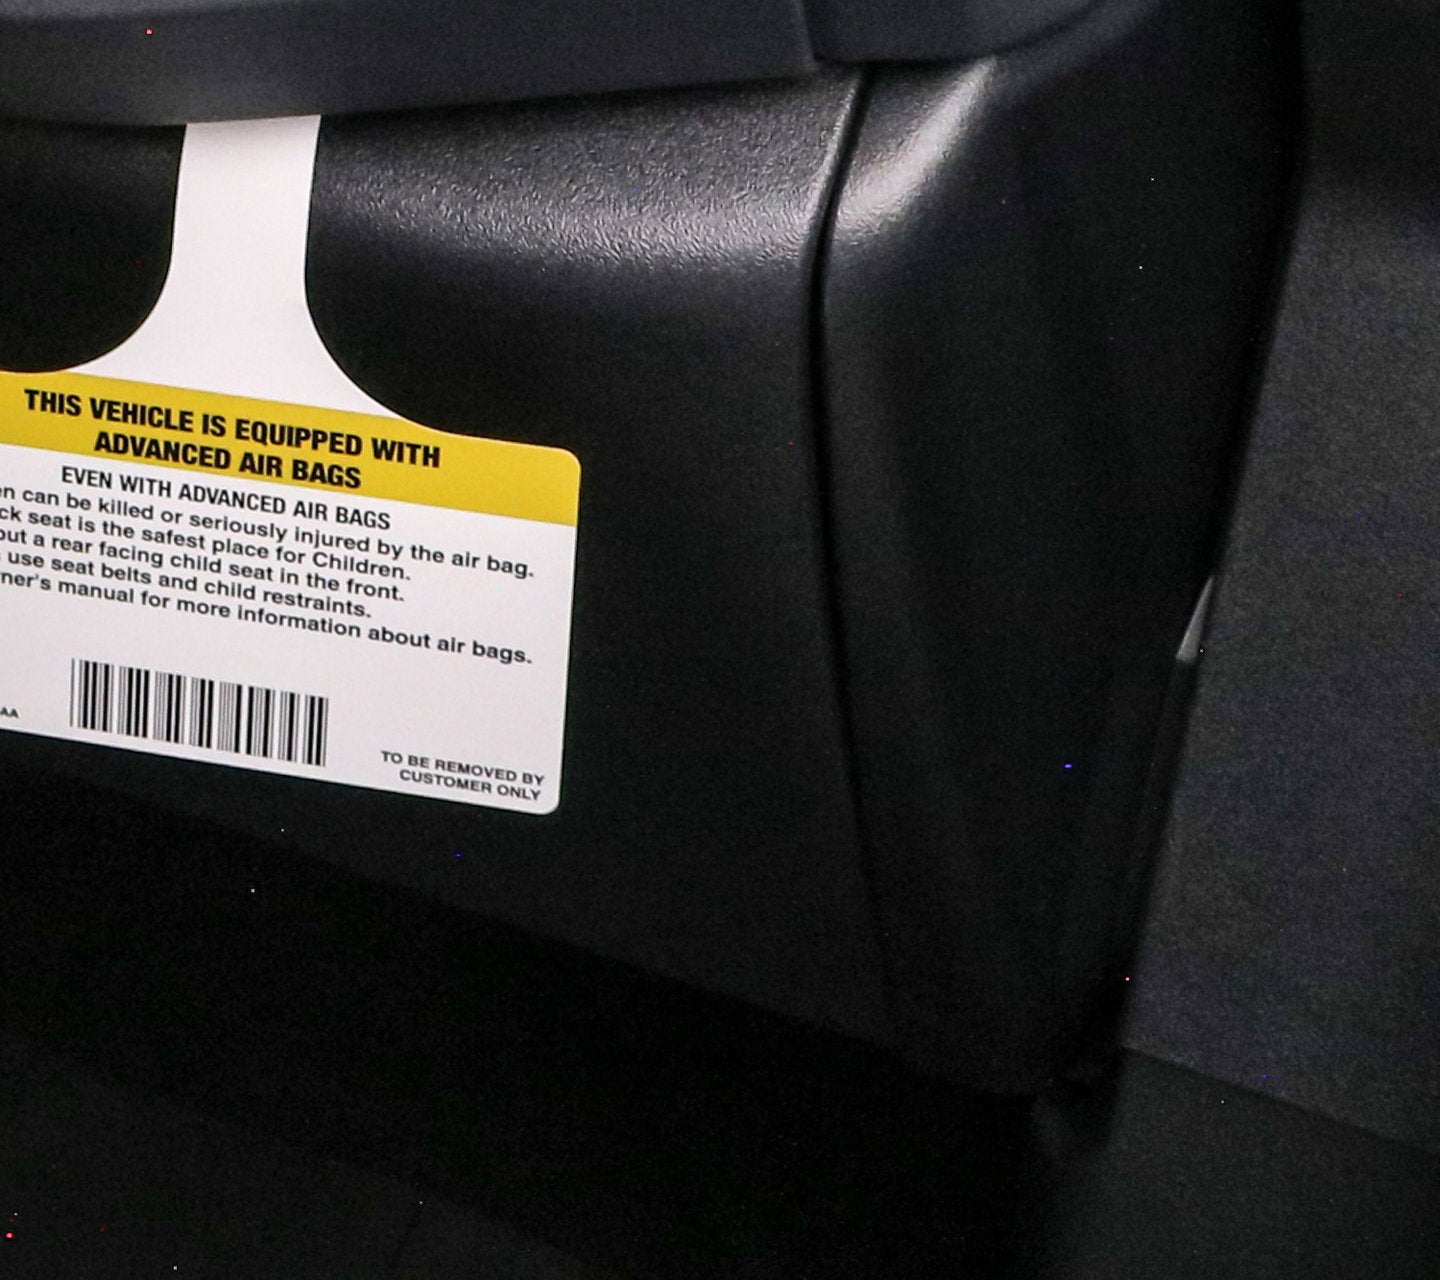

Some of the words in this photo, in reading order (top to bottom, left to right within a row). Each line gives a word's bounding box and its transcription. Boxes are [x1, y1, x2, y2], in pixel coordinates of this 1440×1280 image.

[23, 388, 83, 418] THIS
[88, 396, 195, 434] VEHICLE
[201, 412, 227, 438] IS
[234, 417, 364, 457] EQUIPPED
[370, 436, 441, 469] WITH
[93, 430, 232, 471] ADVANCED
[237, 451, 284, 479] AIR
[290, 458, 362, 490] BAGS
[61, 464, 113, 490] EVEN
[118, 473, 172, 499] WITH
[177, 482, 287, 515] ADVANCED
[292, 499, 329, 523] AIR
[334, 505, 391, 531] BAGS
[21, 489, 60, 507] can
[66, 491, 92, 512] be
[97, 496, 155, 521] killed
[160, 509, 184, 525] or
[188, 514, 289, 544] seriously
[294, 525, 371, 553] injured
[376, 538, 404, 562] by
[409, 544, 446, 564] the
[450, 551, 481, 569] air
[486, 554, 534, 580] bag.
[27, 511, 72, 531] seat
[77, 515, 97, 534] is
[101, 520, 136, 540] the
[141, 528, 206, 551] safest
[211, 537, 270, 560] place
[275, 545, 307, 565] for
[311, 551, 411, 581] Children.
[32, 533, 46, 548] a
[51, 536, 94, 555] rear
[98, 540, 164, 569] facing
[169, 552, 223, 575] child
[228, 563, 274, 583] seat
[279, 566, 300, 586] in
[305, 572, 341, 592] the
[345, 577, 405, 602] front.
[7, 551, 45, 569] use
[50, 558, 95, 577] seat
[100, 561, 153, 585] belts
[157, 574, 198, 592] and
[203, 579, 257, 601] child
[262, 589, 372, 619] restraints.
[57, 580, 135, 604] manual
[140, 589, 171, 609] for
[176, 598, 232, 619] more
[237, 604, 362, 639] information
[367, 625, 431, 650] about
[436, 636, 467, 654] air
[471, 639, 533, 665] bags.
[380, 749, 403, 765] TO
[407, 754, 430, 769] BE
[434, 758, 518, 783] REMOVED
[522, 772, 545, 786] BY
[399, 768, 493, 794] CUSTOMER
[496, 783, 542, 802] ONLY
